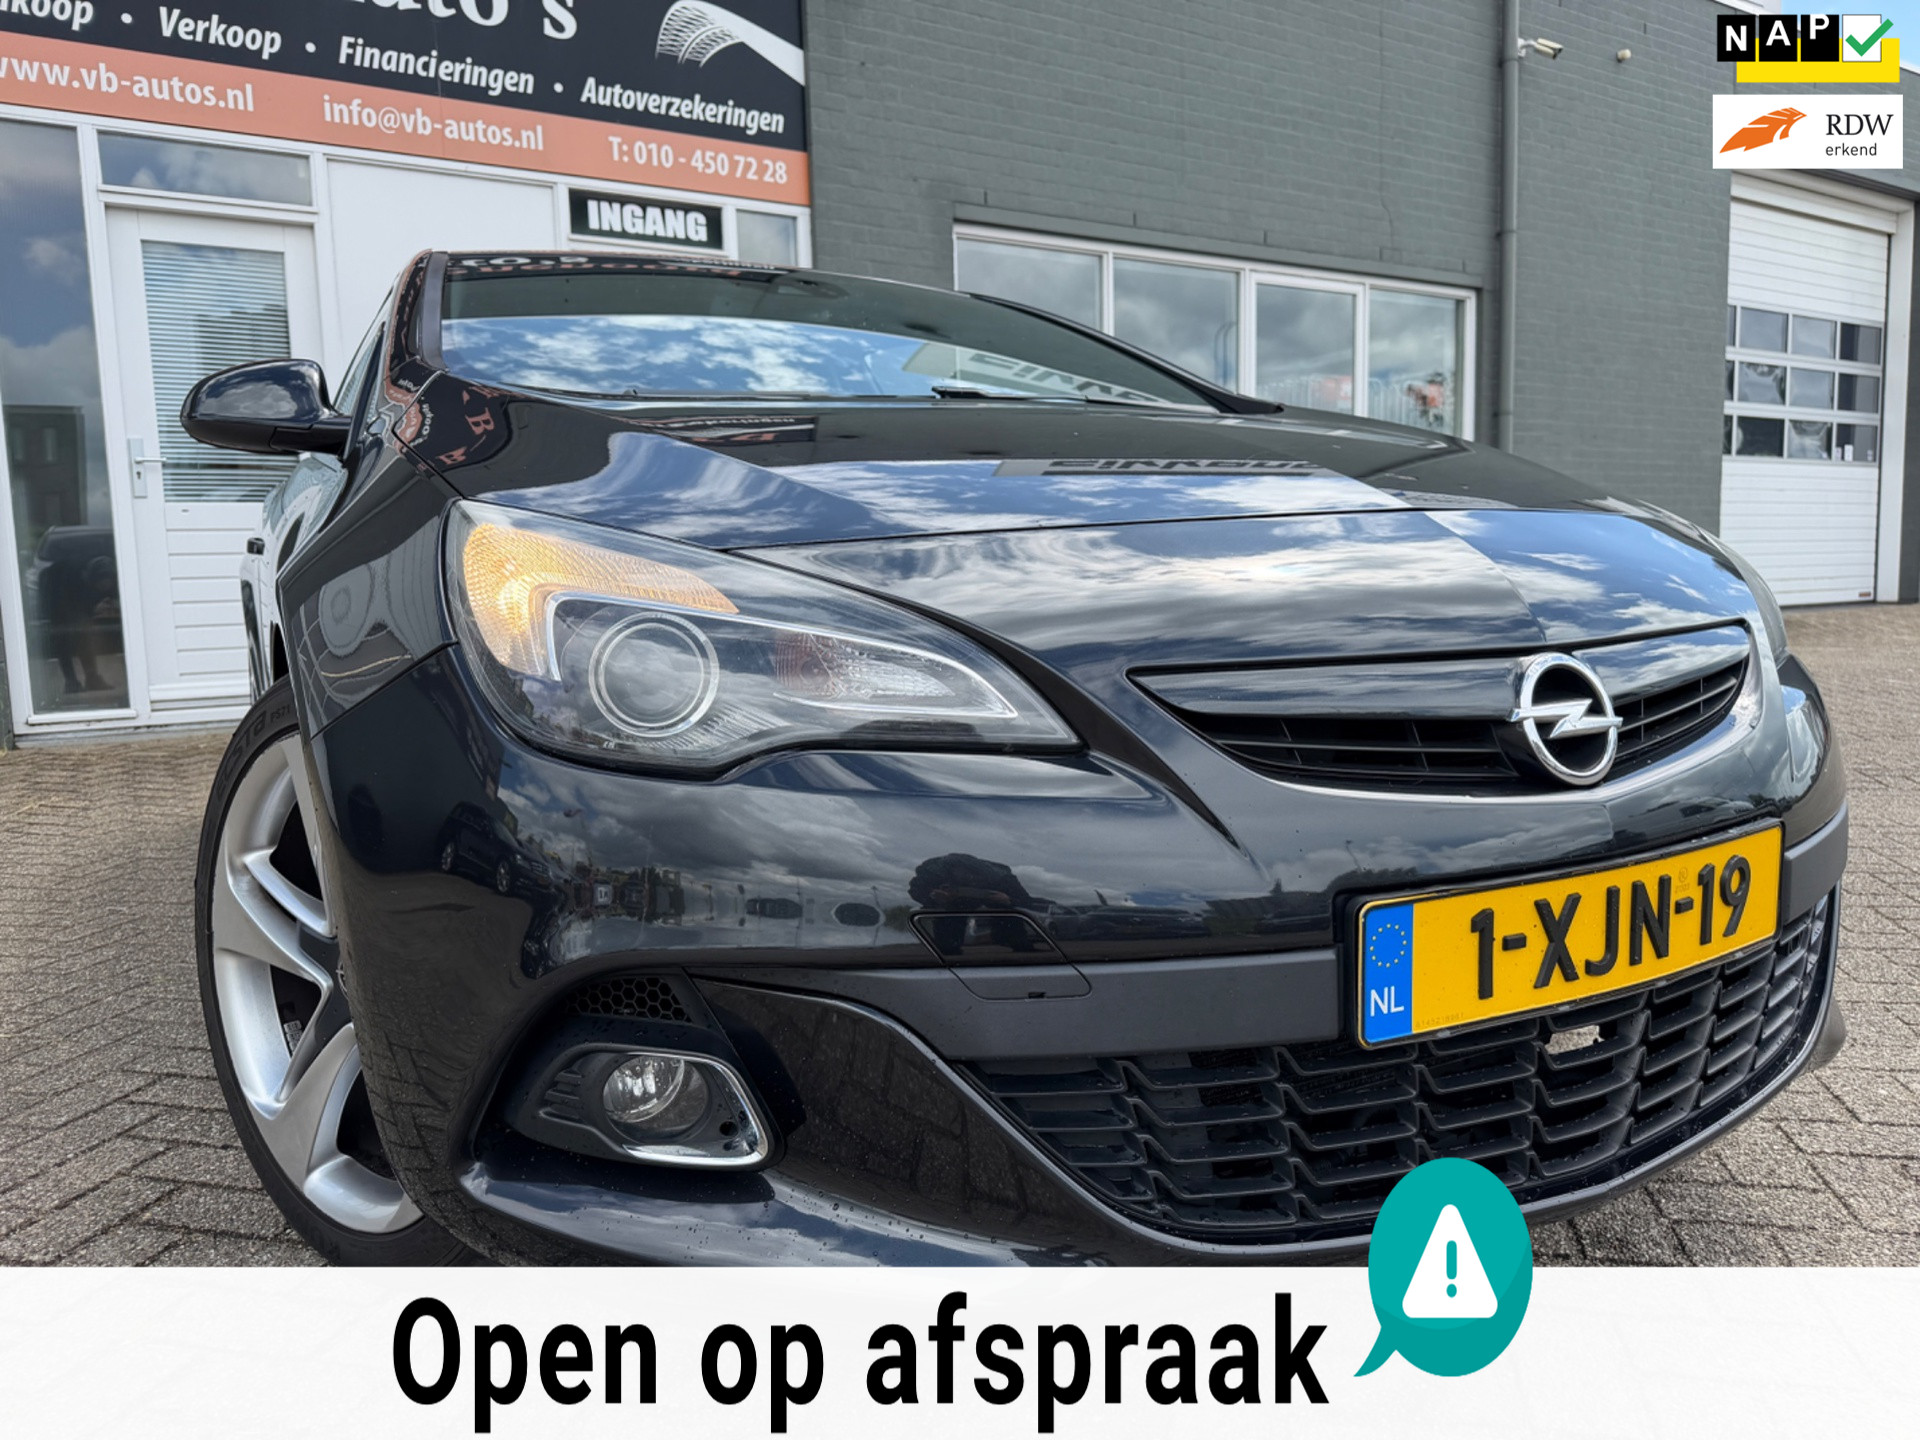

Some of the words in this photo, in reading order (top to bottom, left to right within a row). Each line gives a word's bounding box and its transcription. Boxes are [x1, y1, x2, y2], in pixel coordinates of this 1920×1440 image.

[0, 56, 255, 112] ww.vb-autos.nl
[323, 94, 544, 152] info@vb-autos.nl
[608, 135, 629, 163] T:
[633, 141, 674, 169] 010
[690, 149, 730, 176] 450
[734, 155, 758, 180] 72
[763, 160, 788, 185] 28
[159, 6, 282, 60] Verkoop
[338, 35, 534, 96] Financieringen
[580, 76, 785, 136] Autoverzekeringen
[587, 199, 708, 242] INGANG
[1470, 854, 1751, 1000] 1-XJN-19
[1370, 986, 1405, 1017] NL
